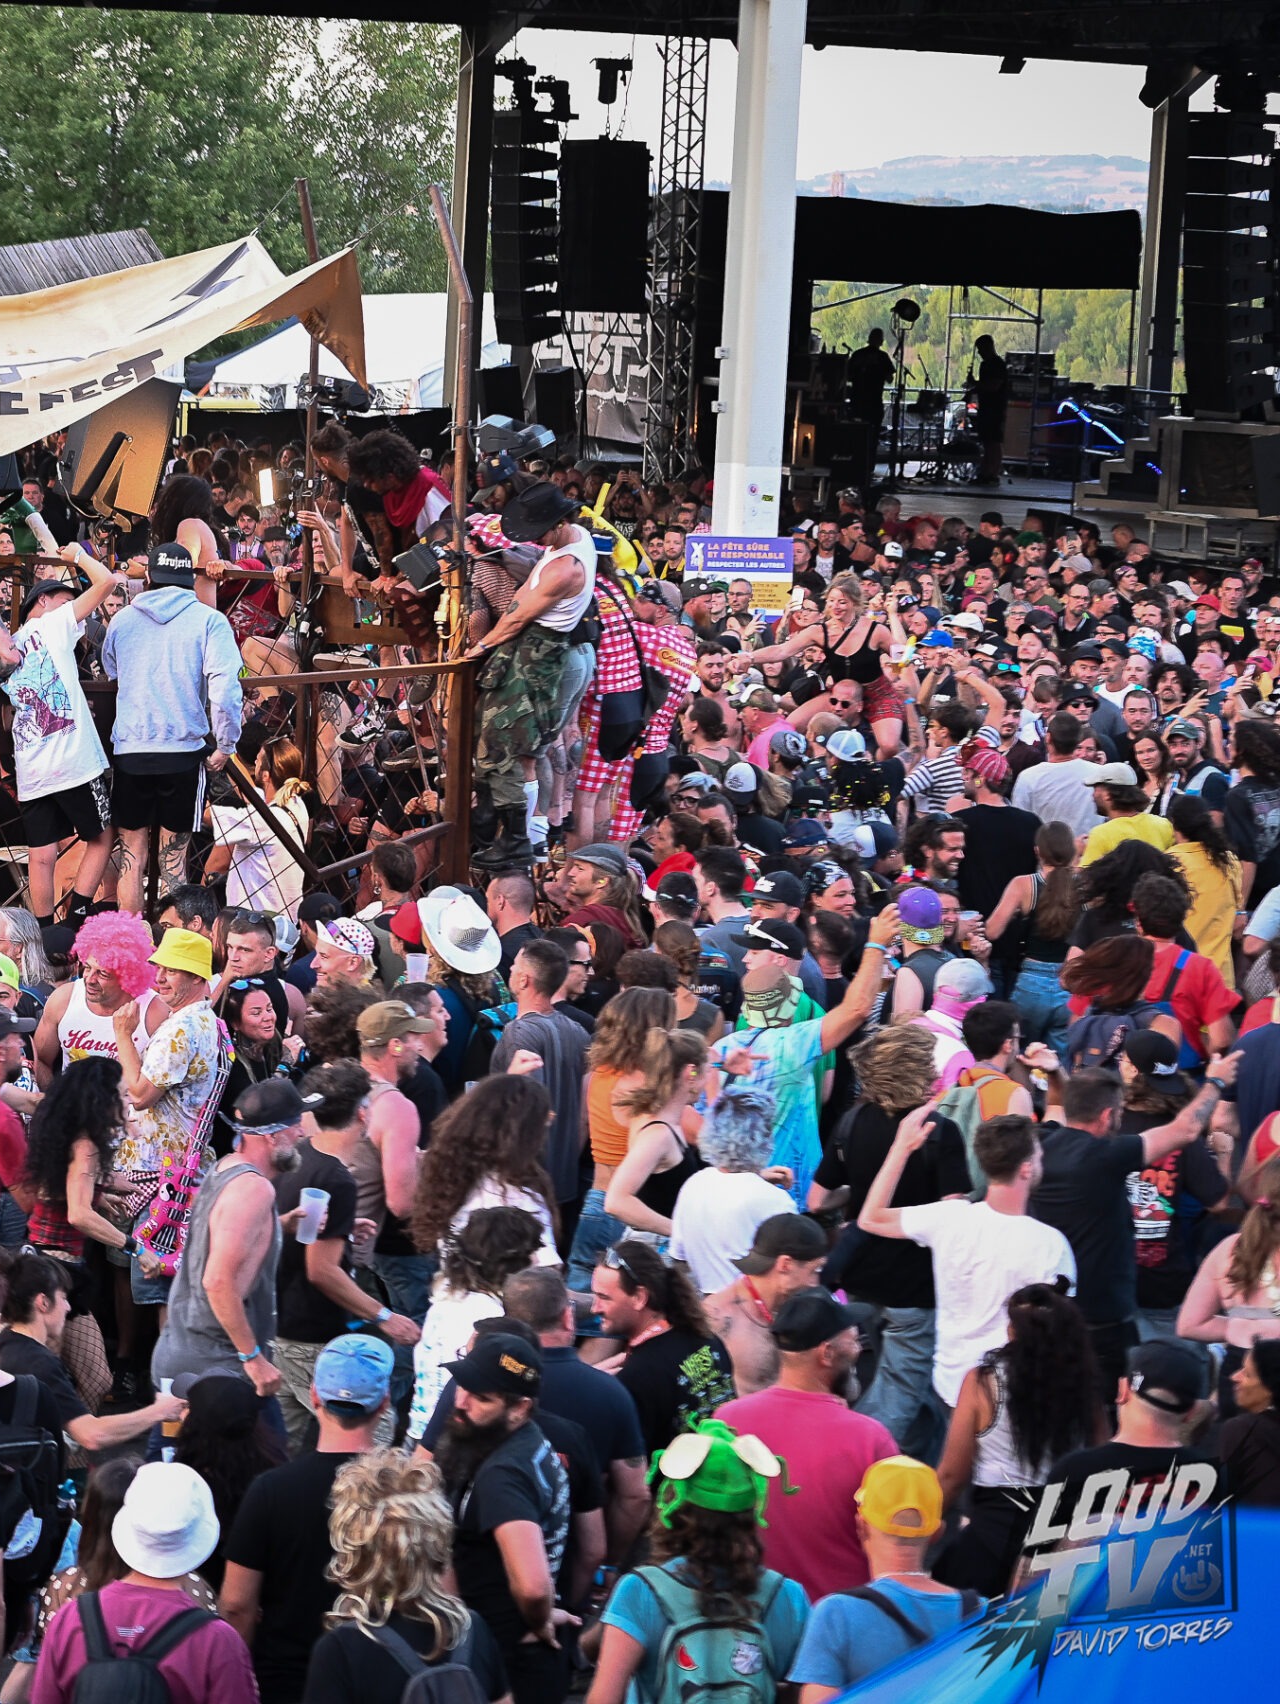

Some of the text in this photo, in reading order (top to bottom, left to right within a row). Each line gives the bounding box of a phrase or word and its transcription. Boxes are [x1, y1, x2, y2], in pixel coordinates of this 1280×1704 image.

[39, 348, 164, 412] FEST
[707, 543, 720, 551] LA
[722, 541, 744, 551] FÊTE
[707, 551, 785, 560] ET RESPONSABLE
[157, 552, 192, 570] Brujeria
[707, 561, 745, 569] RESPECTER
[745, 561, 758, 569] LES
[759, 561, 786, 569] AUTRES
